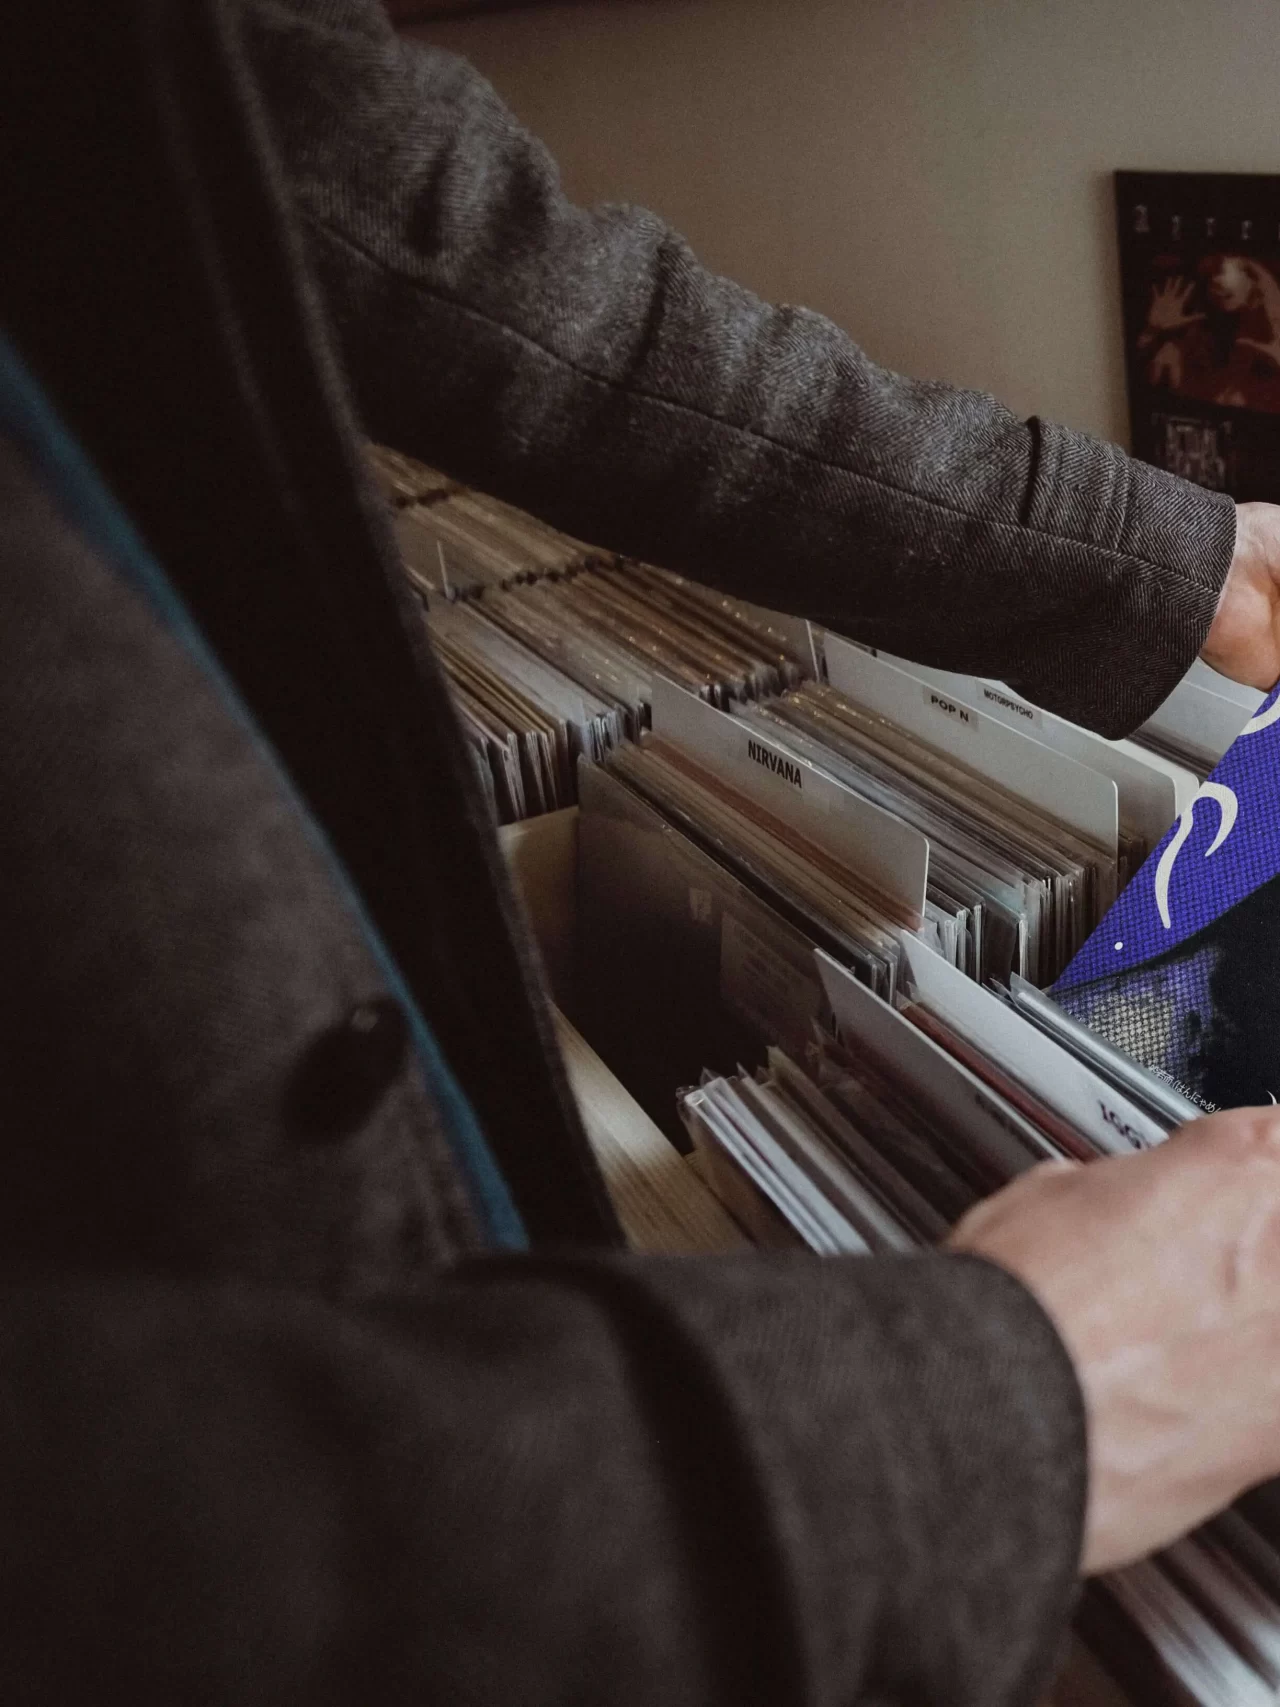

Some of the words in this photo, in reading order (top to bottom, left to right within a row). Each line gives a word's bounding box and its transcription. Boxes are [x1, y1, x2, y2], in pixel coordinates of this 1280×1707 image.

[931, 695, 956, 713] POP
[960, 709, 969, 722] N
[984, 688, 1033, 719] MOTORPSYCHO
[748, 739, 802, 789] NIRVANA
